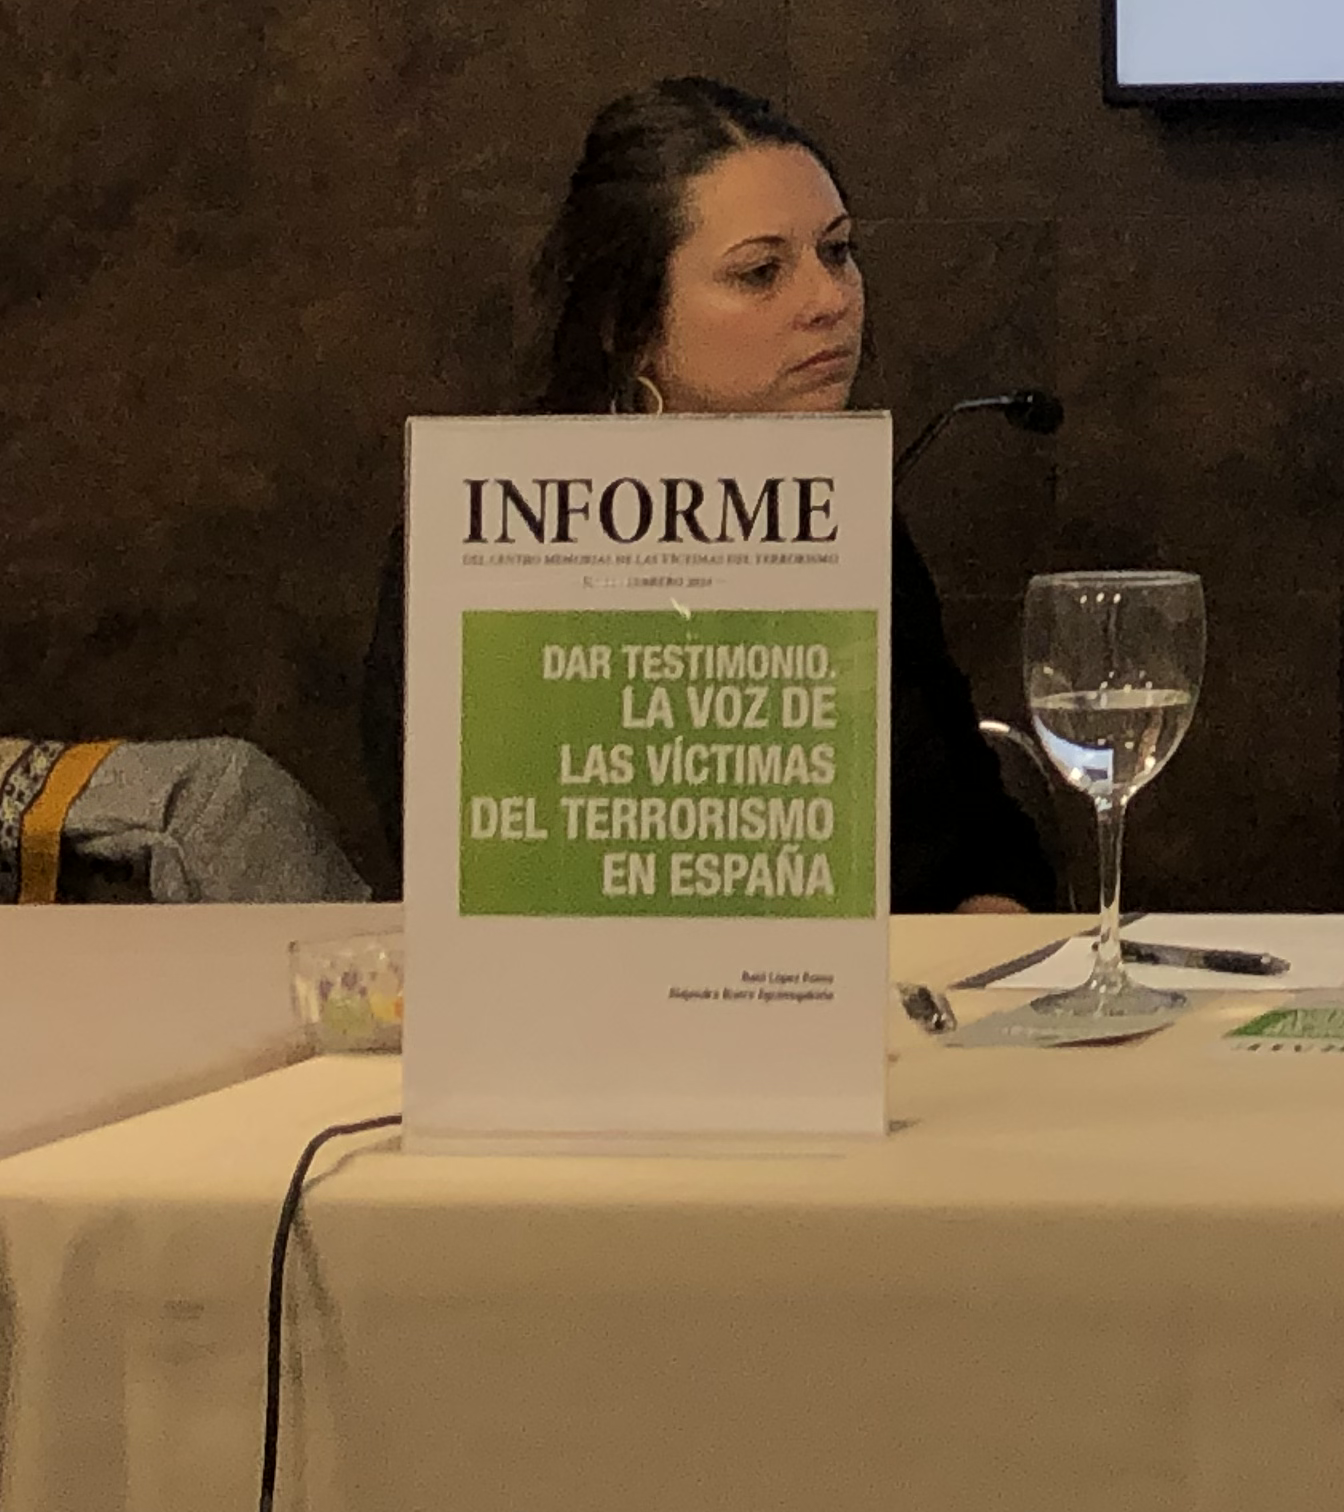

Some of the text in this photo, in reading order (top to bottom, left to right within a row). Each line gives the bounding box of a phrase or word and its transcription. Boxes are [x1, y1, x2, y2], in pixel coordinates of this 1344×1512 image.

[462, 476, 839, 545] INFORME
[543, 644, 837, 680] DAR TESTIMONIO.
[622, 686, 838, 728] LA VOZ DE
[559, 735, 836, 786] LAS VÍCTIMAS
[470, 796, 834, 840] DEL TERRORISMO
[603, 845, 835, 897] EN ESPAÑA
